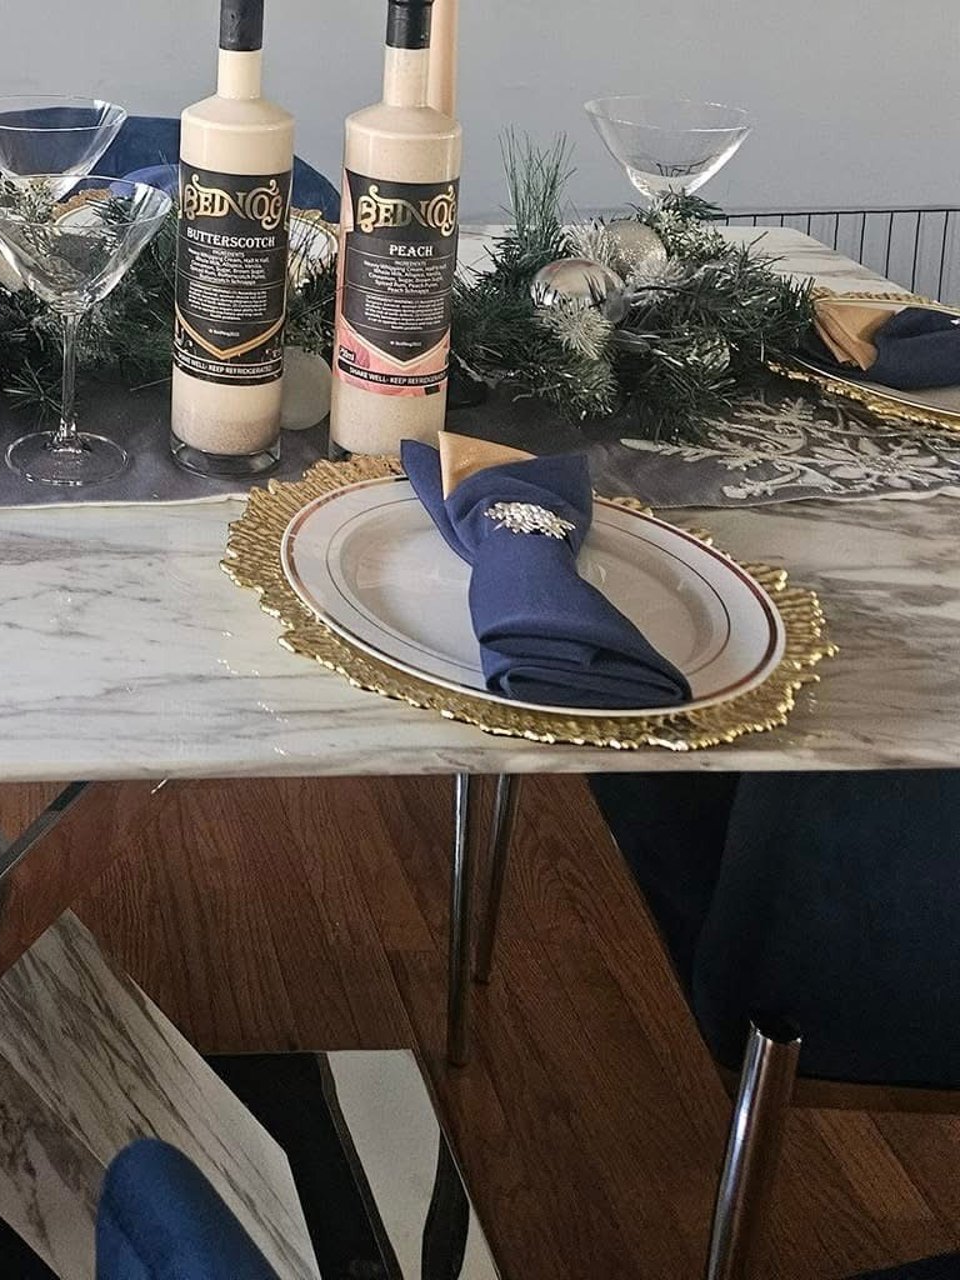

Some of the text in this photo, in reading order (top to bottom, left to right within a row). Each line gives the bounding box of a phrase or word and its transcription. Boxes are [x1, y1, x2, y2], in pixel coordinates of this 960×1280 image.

[186, 227, 276, 248] BUTTERSCOTCH
[389, 244, 434, 257] PEACH
[390, 376, 407, 385] KEEP
